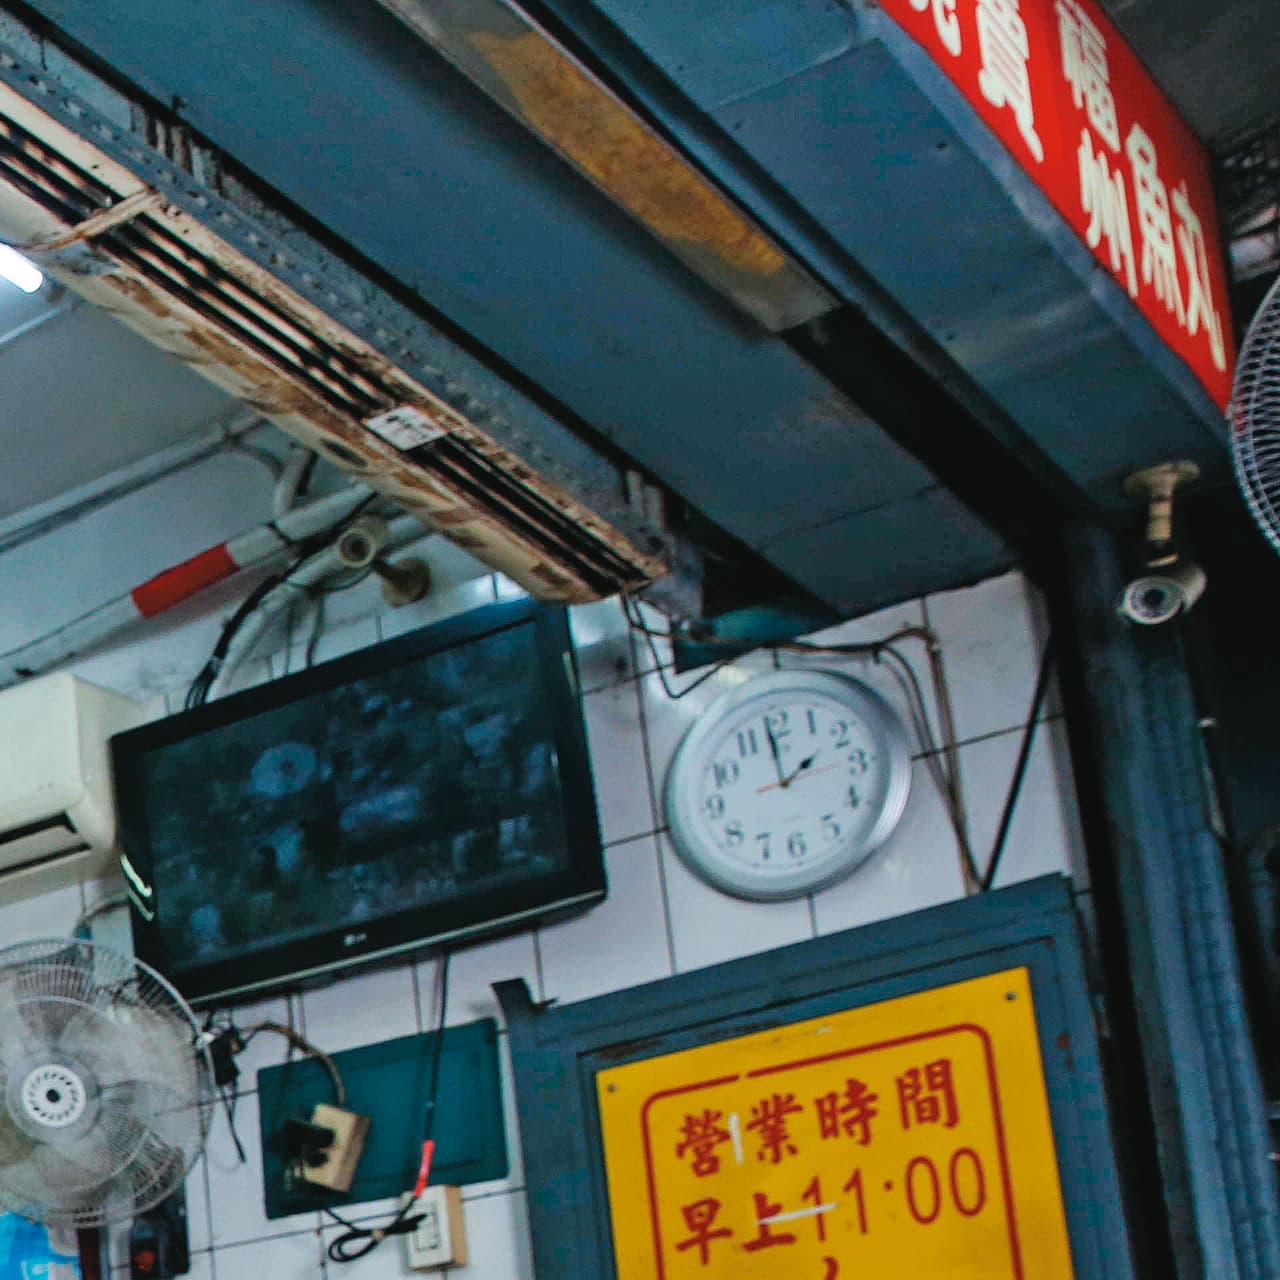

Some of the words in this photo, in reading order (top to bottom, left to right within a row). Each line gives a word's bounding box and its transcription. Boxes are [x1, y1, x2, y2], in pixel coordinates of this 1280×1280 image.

[806, 708, 817, 735] 1
[830, 719, 850, 750] 2
[737, 728, 758, 757] 11
[712, 759, 740, 788] 10
[848, 748, 868, 776] 3
[706, 793, 725, 819] 9
[843, 784, 860, 810] 4
[724, 818, 744, 846] 8
[822, 813, 841, 840] 5
[754, 831, 772, 860] 7
[787, 831, 807, 858] 6
[673, 1056, 963, 1181] 營業時間
